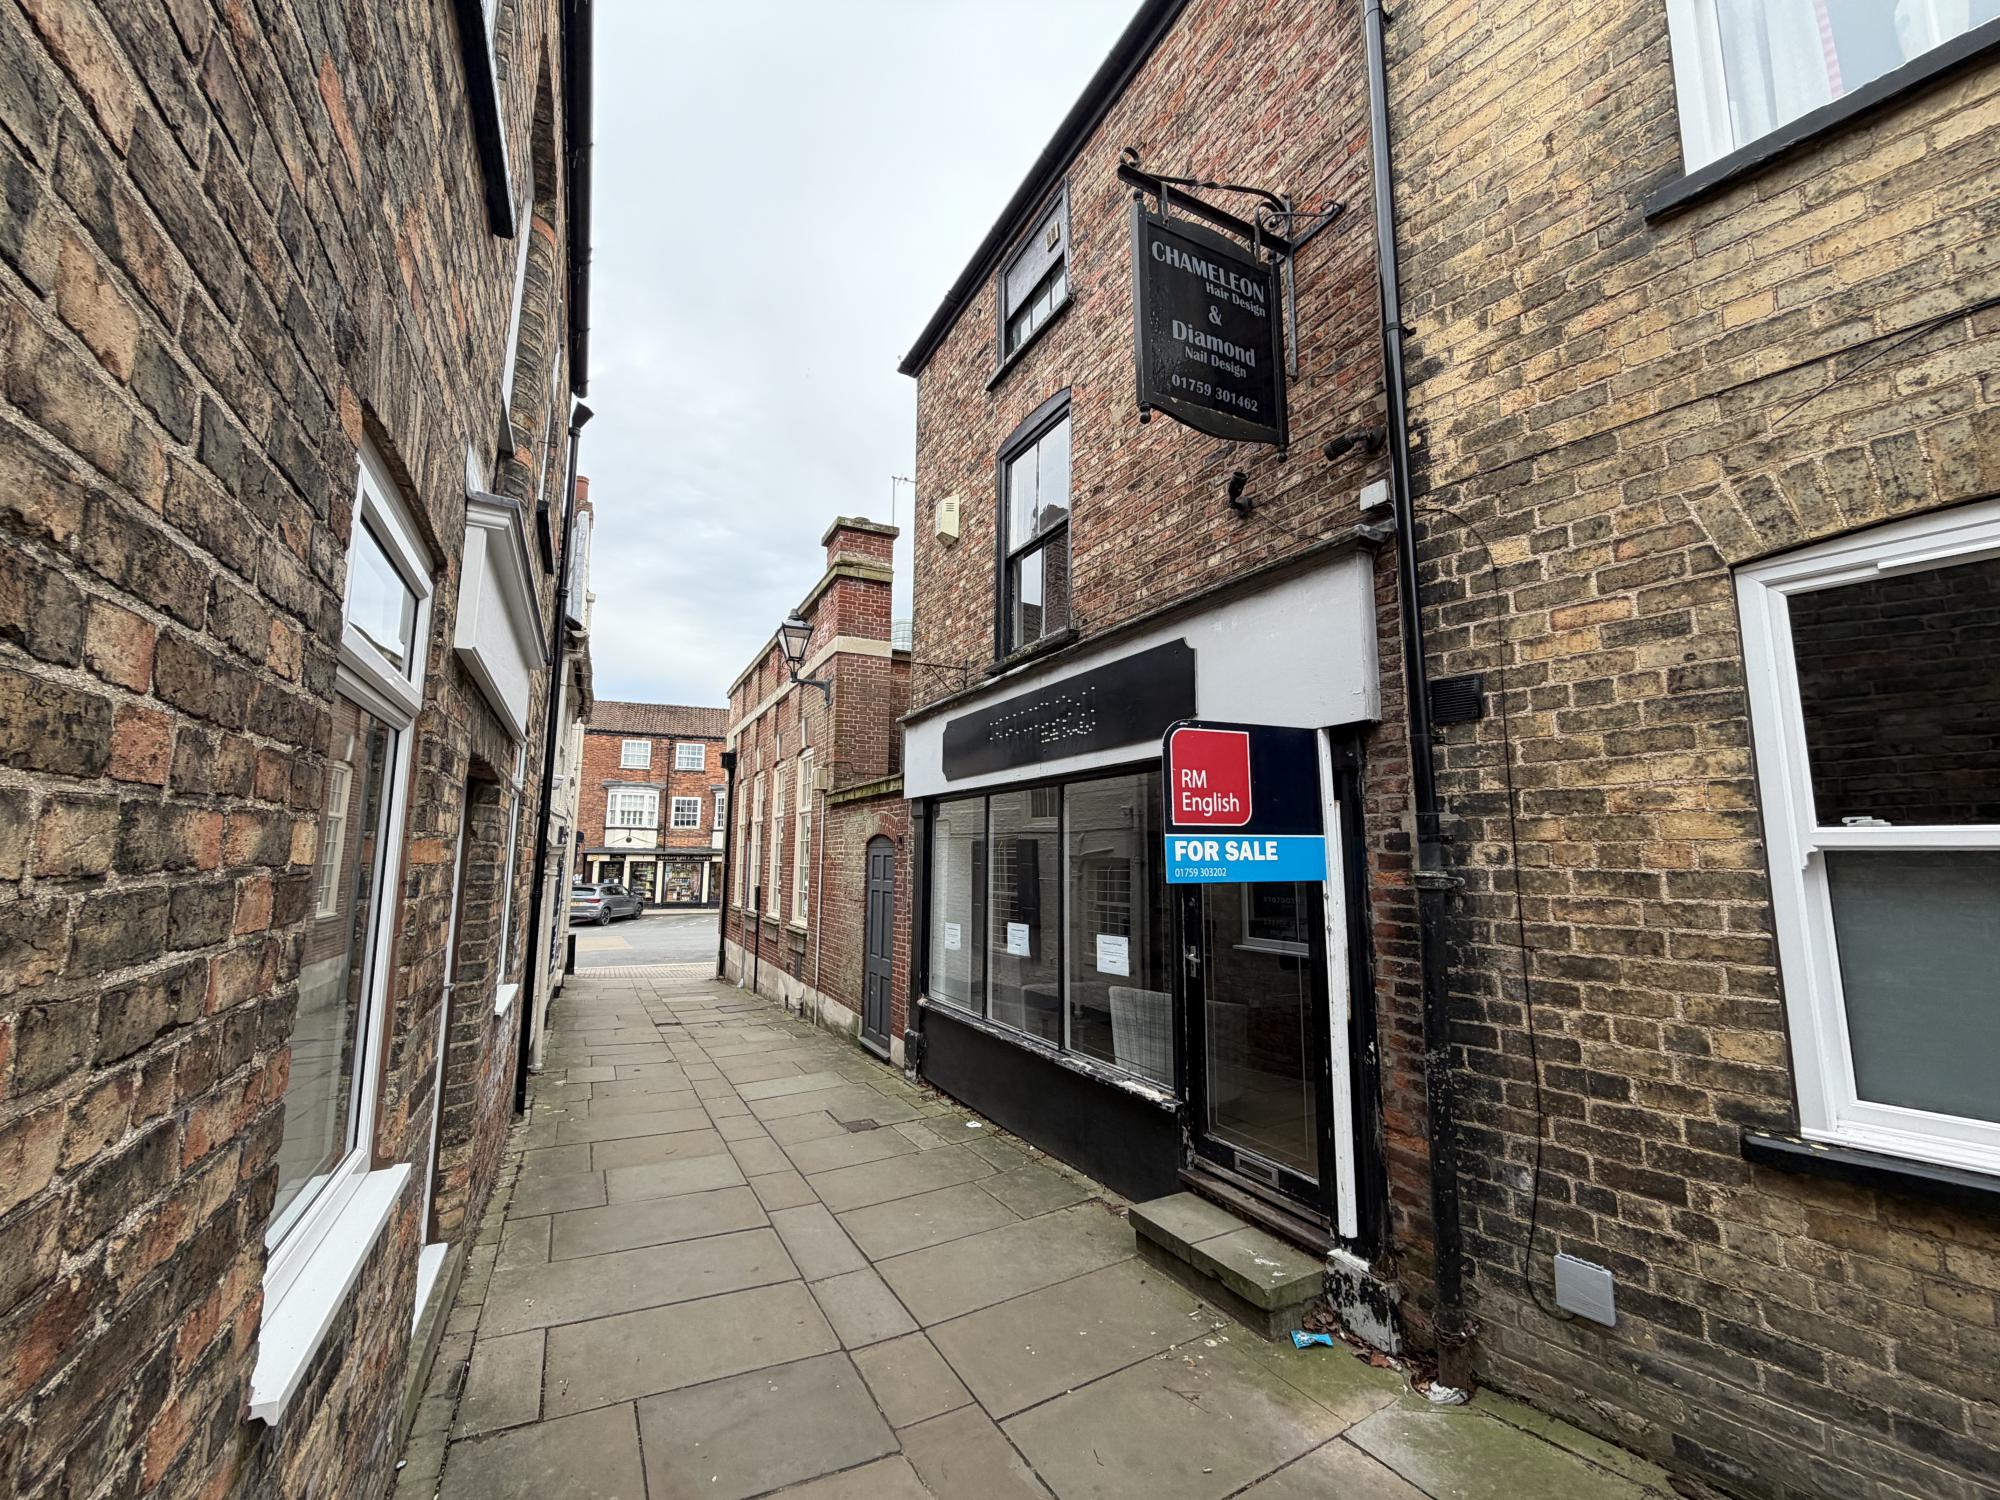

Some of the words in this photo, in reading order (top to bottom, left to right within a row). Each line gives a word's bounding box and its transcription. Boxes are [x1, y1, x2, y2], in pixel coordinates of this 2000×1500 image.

[1151, 240, 1264, 303] CHAMELEON
[1206, 281, 1228, 301] Hair
[1232, 291, 1266, 318] Design
[1208, 305, 1222, 327] &
[1172, 319, 1256, 368] Diamond
[1185, 346, 1208, 365] Nail
[1211, 354, 1247, 378] Design
[1171, 373, 1211, 397] 01759
[1215, 387, 1258, 413] 301462
[1181, 768, 1207, 789] RM
[1182, 791, 1240, 817] English
[1174, 840, 1219, 861] FOR
[1225, 841, 1278, 861] SALE
[1175, 868, 1199, 877] 01759
[1200, 868, 1227, 877] 303202
